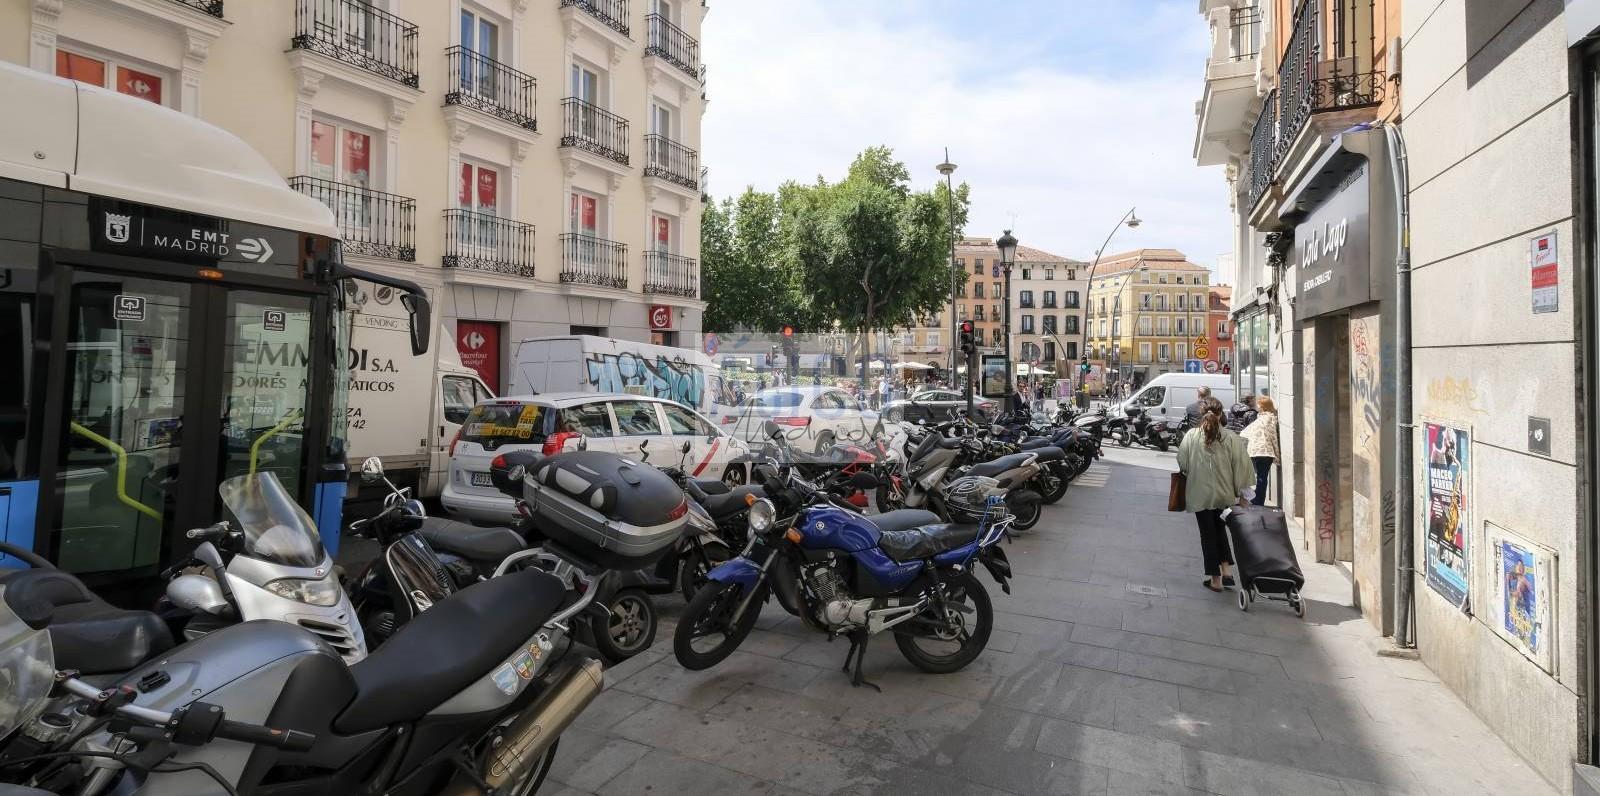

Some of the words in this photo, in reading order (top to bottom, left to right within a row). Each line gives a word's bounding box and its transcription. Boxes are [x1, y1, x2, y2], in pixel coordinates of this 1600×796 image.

[191, 229, 230, 244] EMT
[1302, 228, 1319, 269] Lola
[1322, 218, 1347, 261] Lago
[154, 235, 230, 256] MADRID
[365, 317, 398, 329] VENDING
[371, 358, 399, 373] S.A.
[1430, 467, 1453, 481] MACEO
